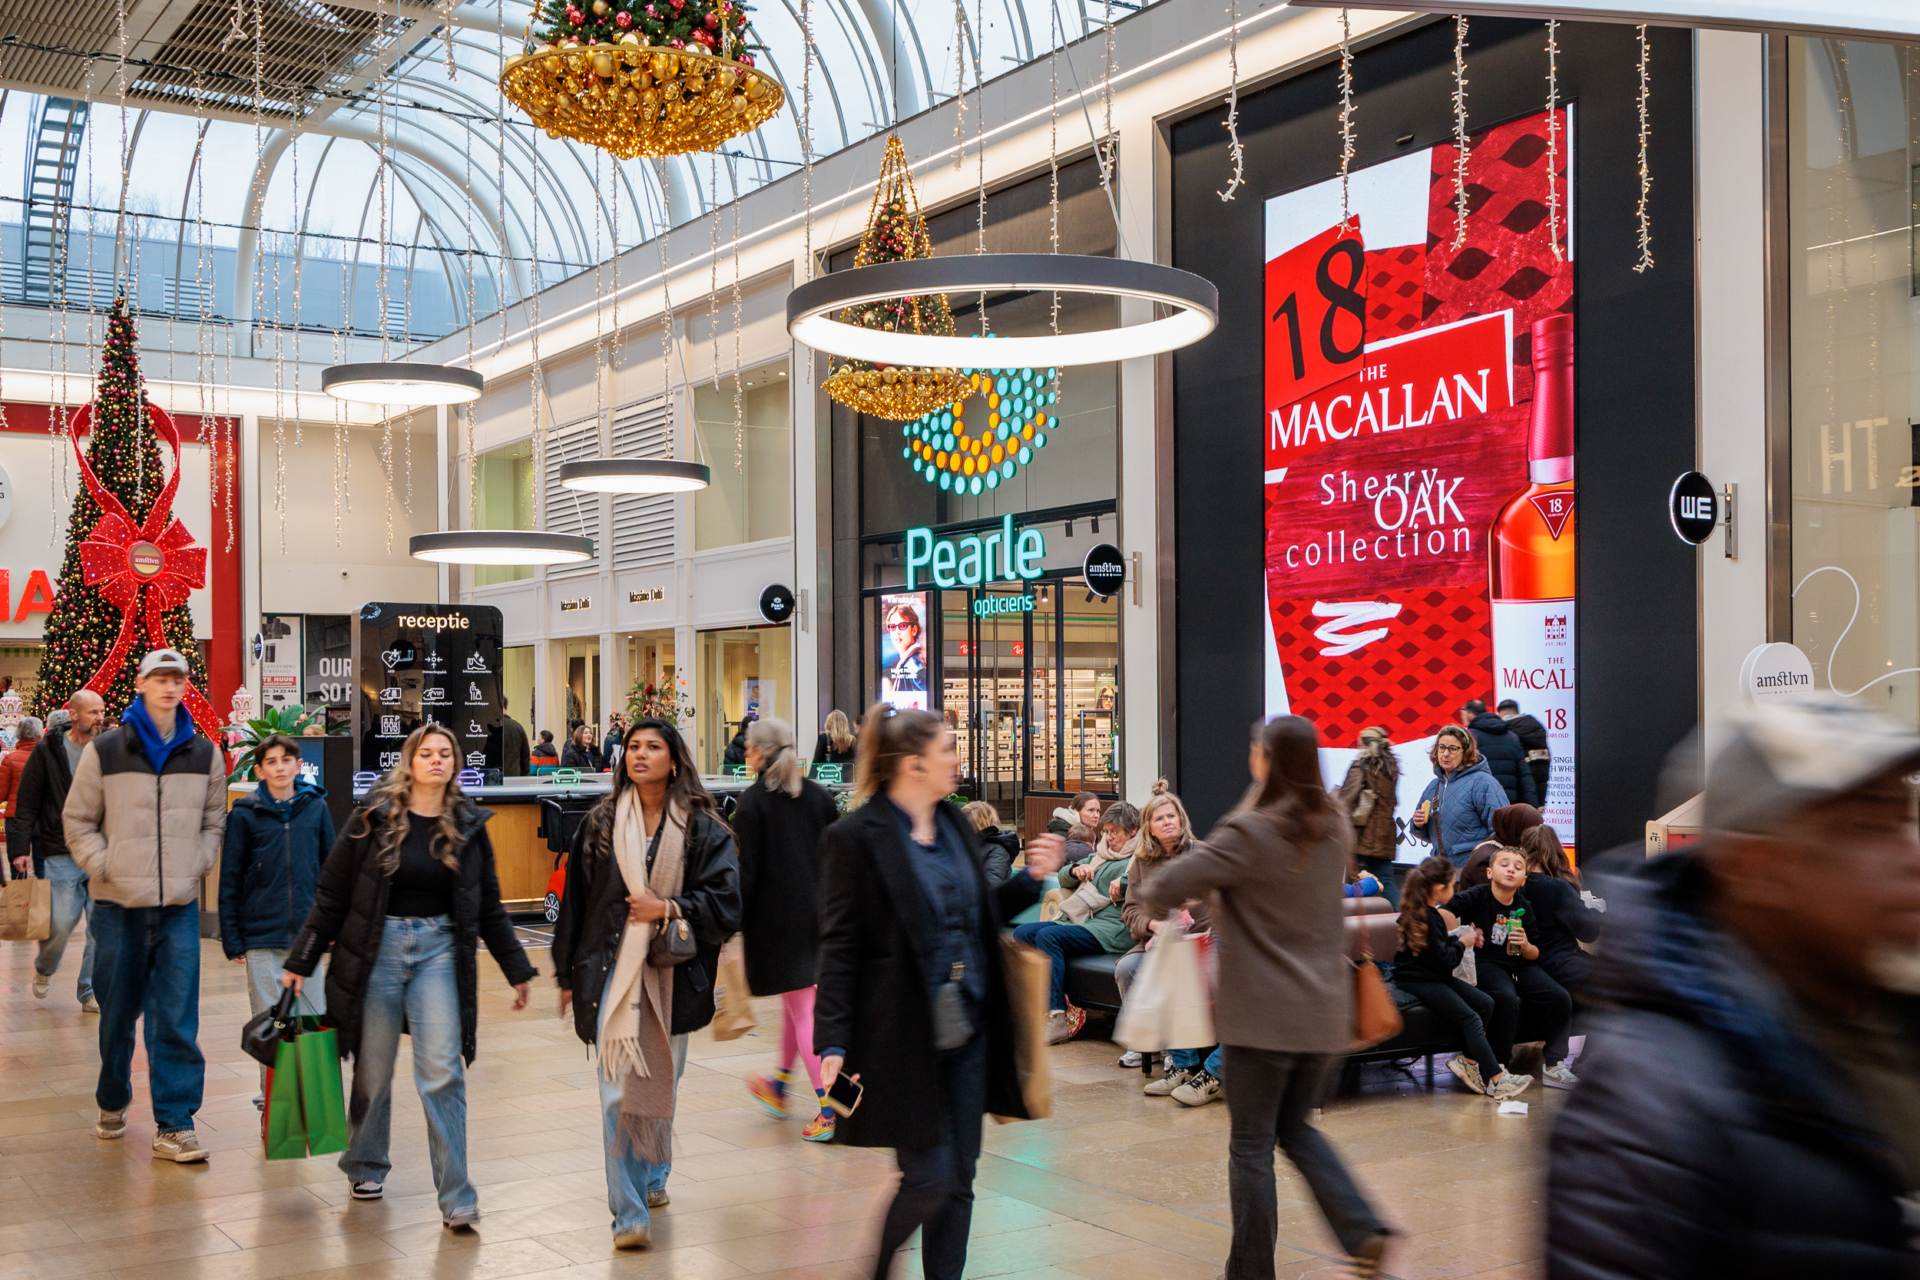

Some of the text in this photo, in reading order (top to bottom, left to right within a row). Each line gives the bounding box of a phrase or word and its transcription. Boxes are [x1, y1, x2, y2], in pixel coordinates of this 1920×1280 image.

[1273, 238, 1366, 381] 18
[1359, 363, 1388, 383] THE
[1270, 368, 1491, 450] MACALLAN
[1320, 468, 1438, 506] Sherry
[1374, 477, 1466, 531] OAK
[1548, 498, 1563, 513] 18
[1681, 496, 1712, 520] WE
[907, 513, 1046, 591] Pearle
[1286, 523, 1471, 567] collection
[1089, 562, 1122, 573] amstlvn
[974, 594, 1035, 620] opticiens
[398, 612, 470, 634] receptie
[319, 657, 352, 678] OUR
[1547, 657, 1565, 665] THE
[1503, 667, 1576, 690] MACAL
[1756, 671, 1809, 688] amstlvn
[319, 682, 341, 702] SO
[1544, 708, 1567, 731] 18
[1553, 756, 1575, 764] SINGL
